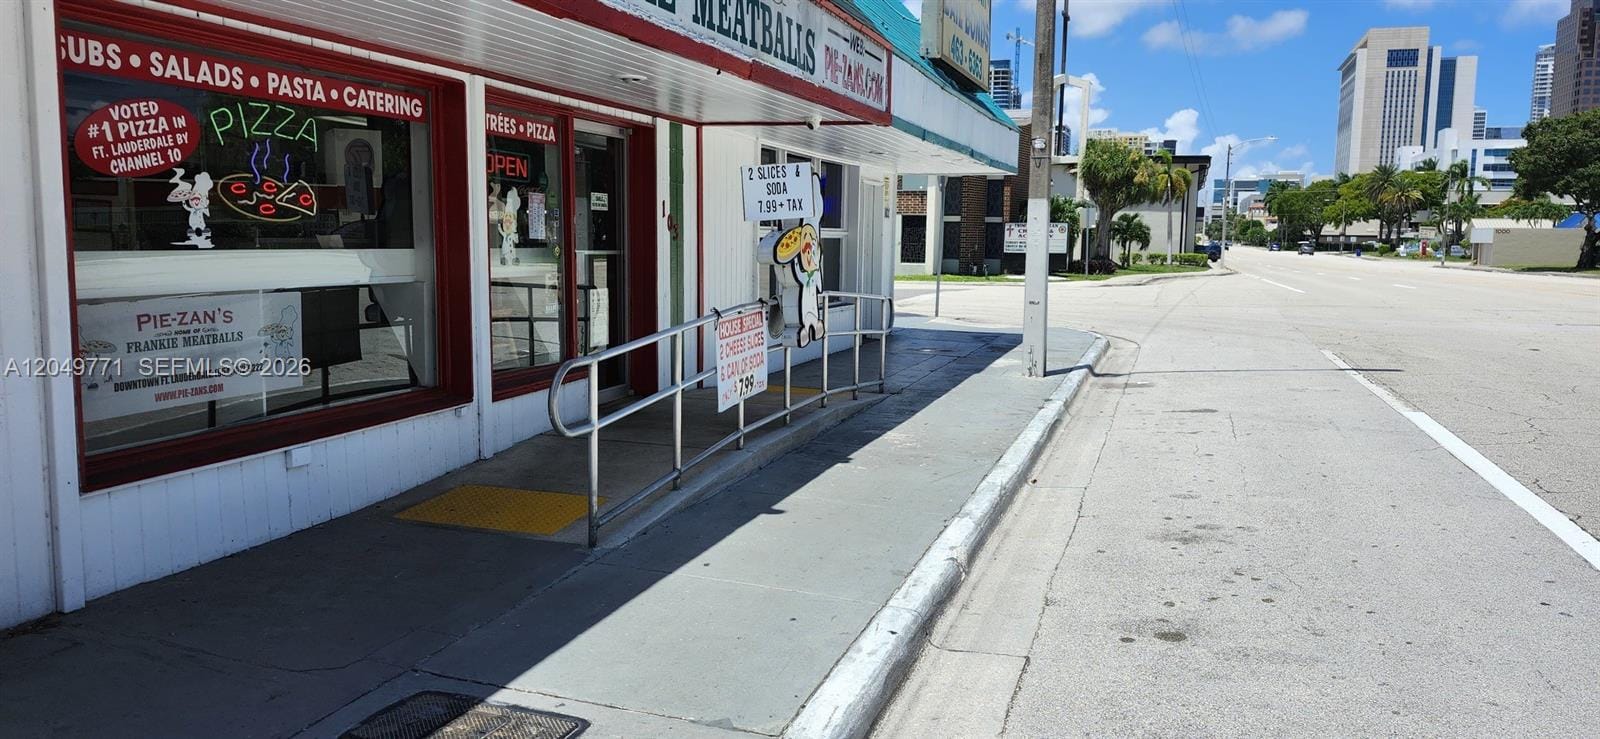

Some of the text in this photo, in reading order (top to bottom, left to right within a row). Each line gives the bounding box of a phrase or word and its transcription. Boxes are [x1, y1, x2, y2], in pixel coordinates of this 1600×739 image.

[150, 51, 244, 90] SALADS
[267, 71, 327, 103] PASTA
[343, 86, 423, 118] CATERING
[109, 101, 159, 120] VOTED
[88, 115, 187, 142] #1 PIZZA IN
[210, 102, 318, 152] PIZZA
[526, 121, 556, 142] PIZZA
[92, 131, 189, 159] FT. LAUDERDALE BY
[110, 148, 182, 174] CHANNEL 10
[487, 153, 528, 178] OPEN
[748, 164, 801, 180] 2 SLICES &
[766, 182, 788, 195] SODA
[788, 198, 804, 211] TAX
[136, 307, 234, 332] PIE-ZAN'S
[720, 320, 742, 339] HOUSE
[126, 331, 244, 354] FRANKIE MEATBALLS
[720, 343, 725, 360] 2
[747, 331, 764, 349] SLICES
[749, 351, 764, 370] SODA
[114, 376, 160, 393] DOWNTOWN
[160, 375, 170, 386] FT.
[154, 383, 225, 402] WWW.PIE-ZANS.COM
